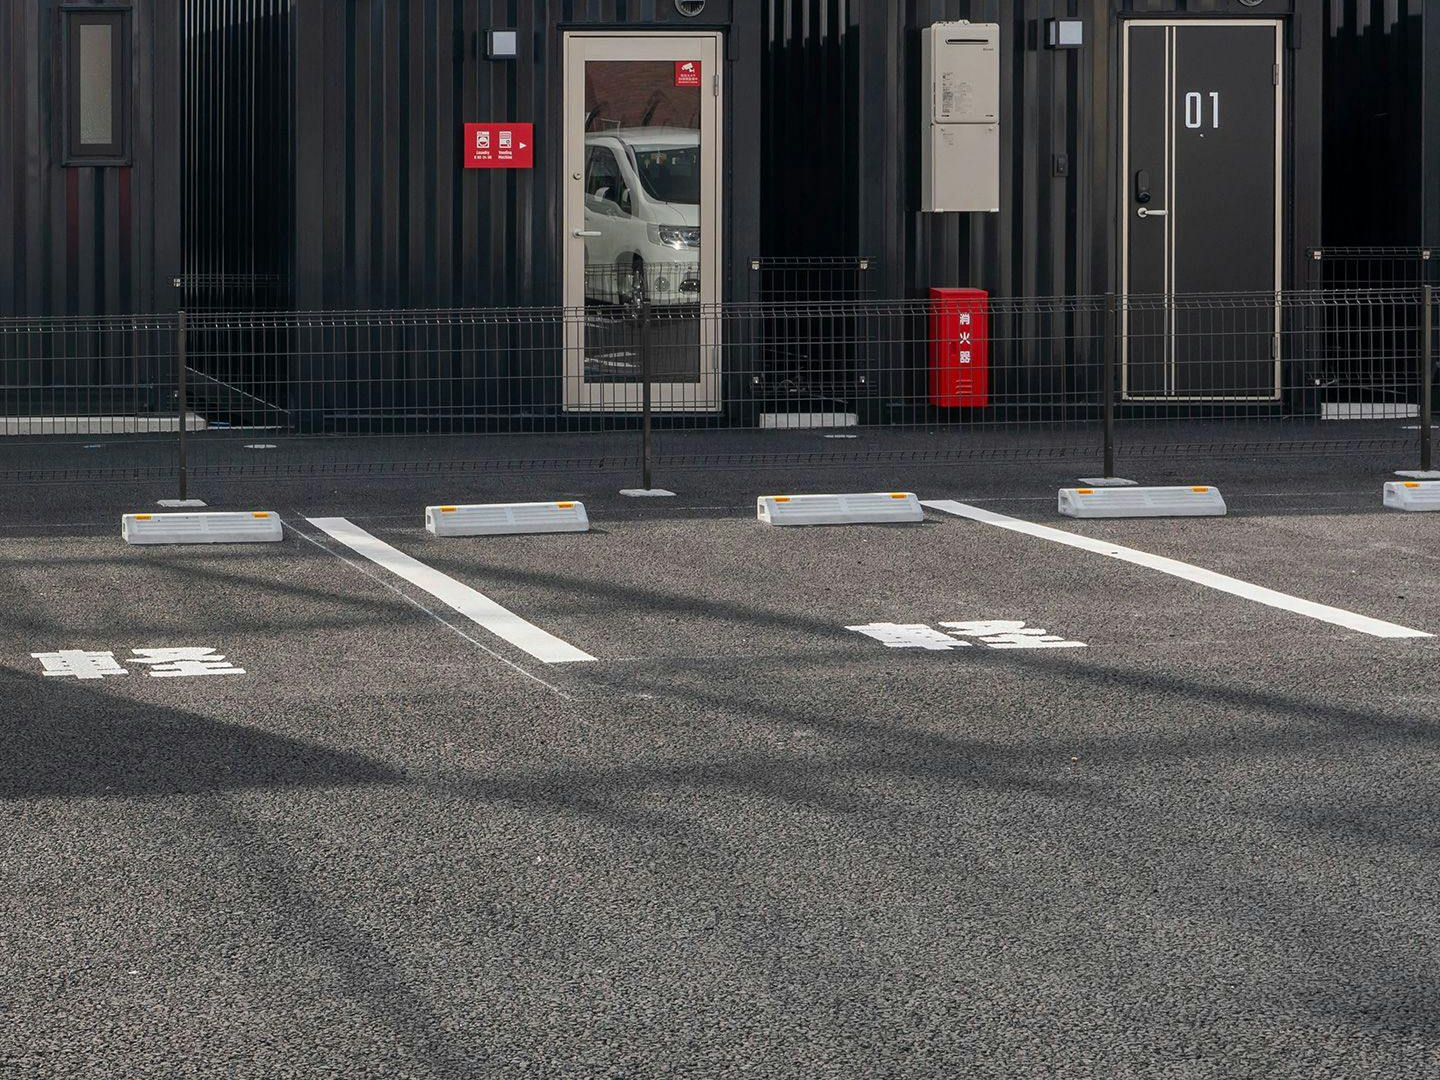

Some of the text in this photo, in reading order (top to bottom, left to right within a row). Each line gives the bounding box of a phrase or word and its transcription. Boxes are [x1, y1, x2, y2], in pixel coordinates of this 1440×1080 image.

[1185, 92, 1219, 128] 01
[959, 313, 971, 363] 消火器
